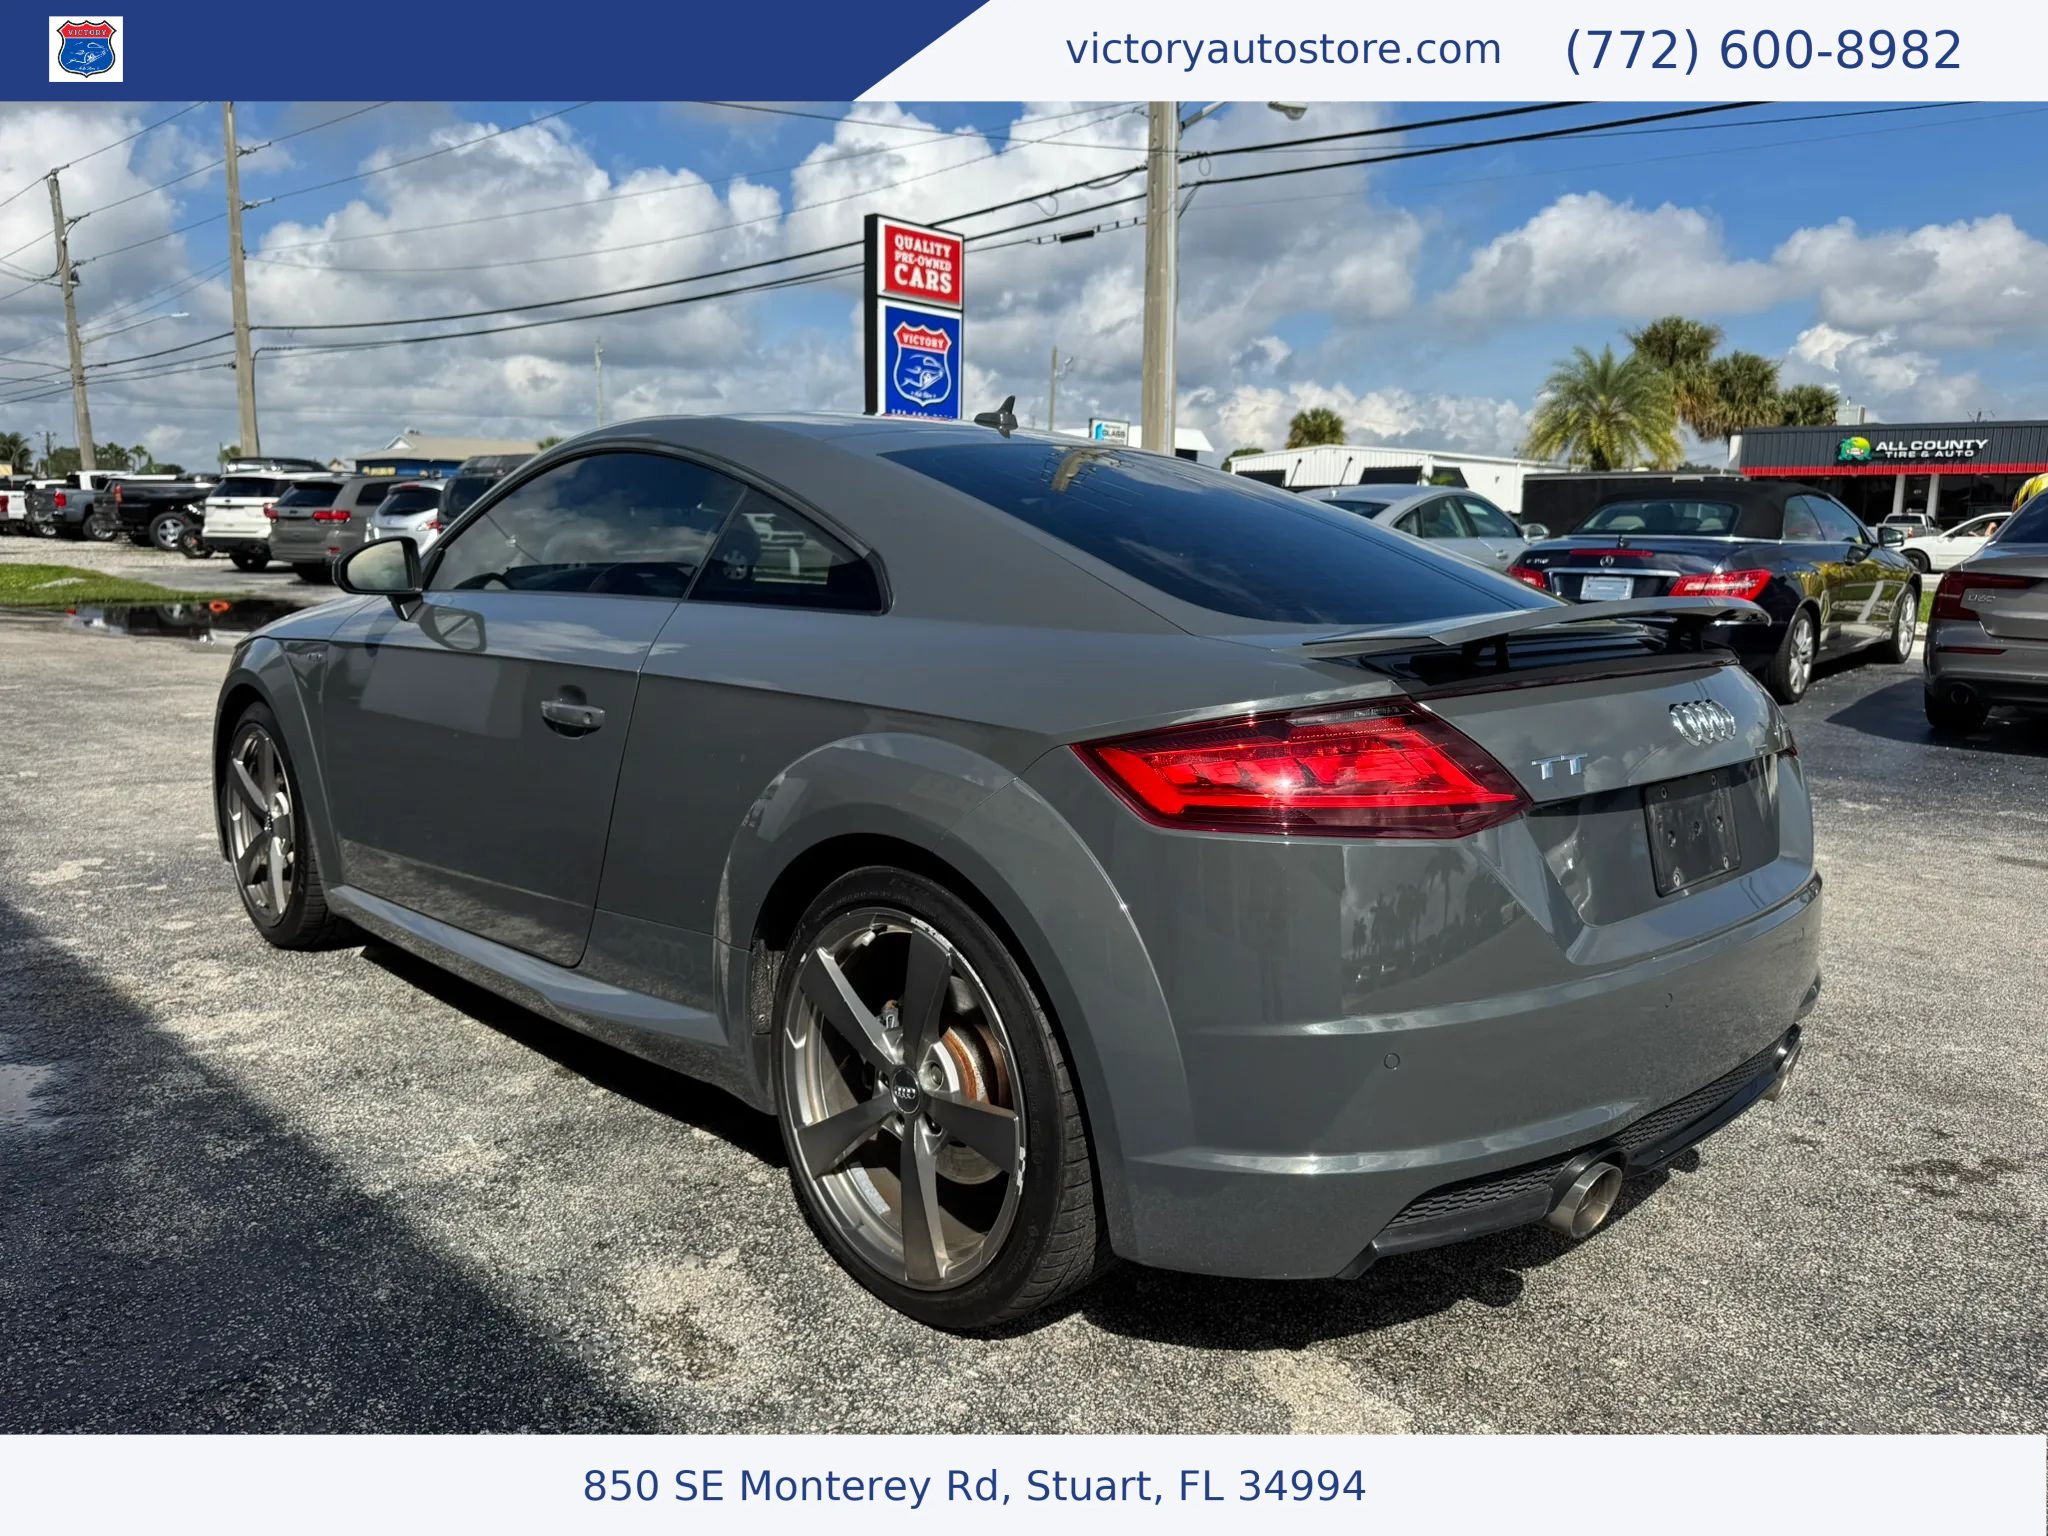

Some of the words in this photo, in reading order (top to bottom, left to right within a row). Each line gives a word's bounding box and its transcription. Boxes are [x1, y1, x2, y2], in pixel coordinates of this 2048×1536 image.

[894, 233, 952, 258] QUALITY
[894, 250, 952, 272] PRE-OWNED
[894, 263, 952, 294] CARS
[902, 333, 944, 348] VICTORY
[1876, 441, 1908, 451] ALL
[1911, 439, 1989, 450] COUNTY
[1531, 753, 1588, 780] TT
